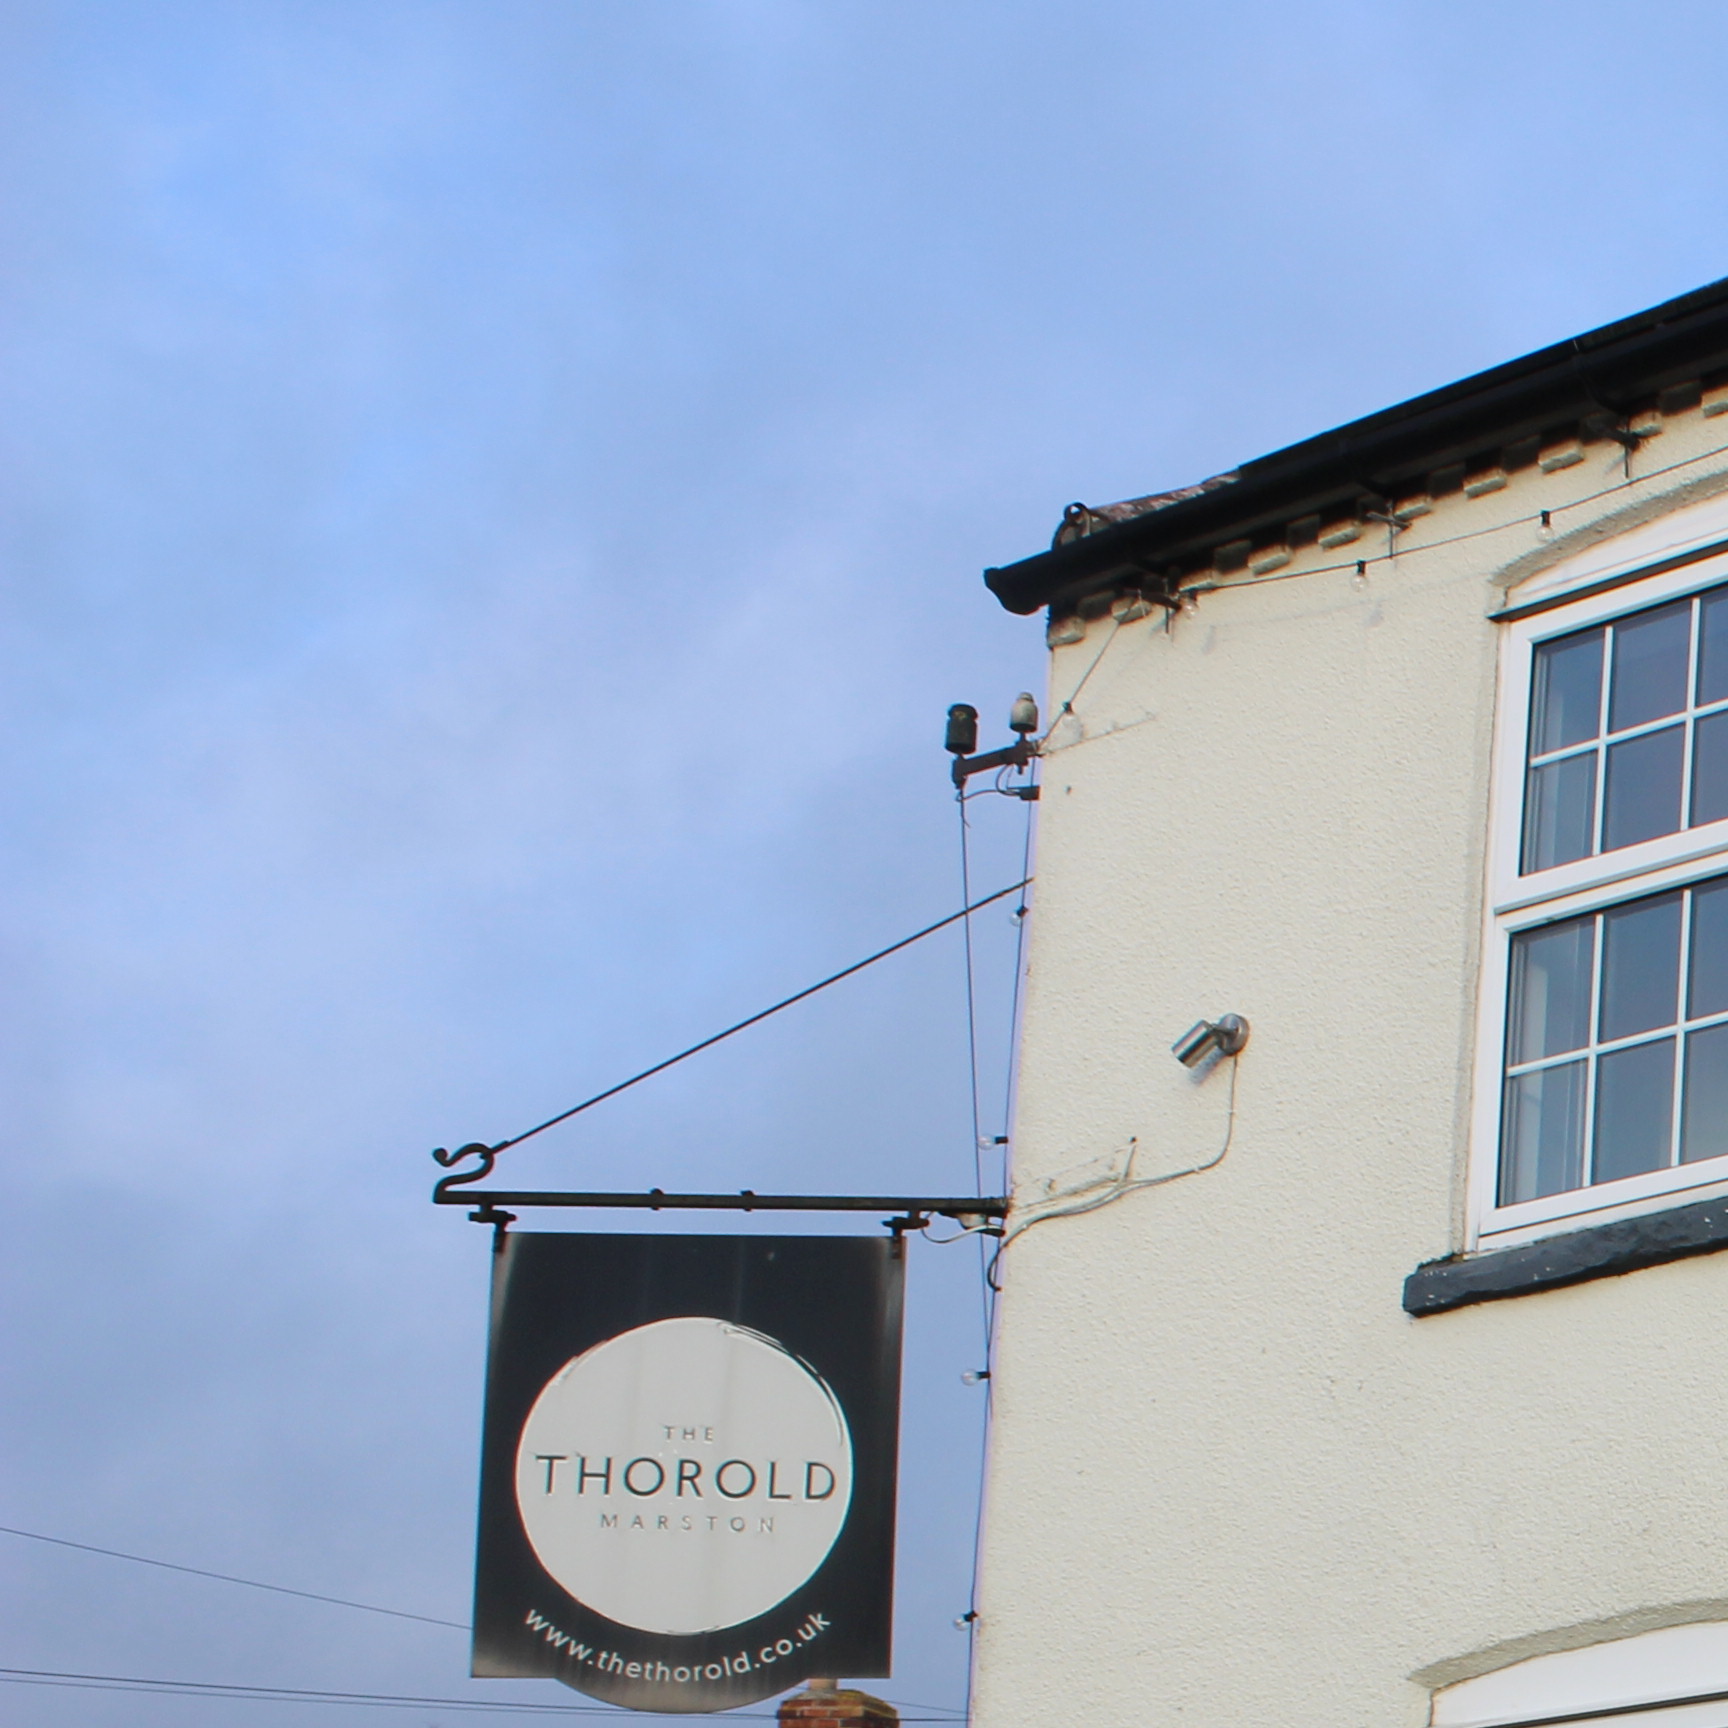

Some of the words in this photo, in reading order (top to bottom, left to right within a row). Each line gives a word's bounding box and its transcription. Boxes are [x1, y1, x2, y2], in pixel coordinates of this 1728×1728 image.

[663, 1423, 715, 1443] THE
[536, 1454, 836, 1502] THOROLD
[600, 1512, 777, 1534] MARSTON
[524, 1608, 832, 1684] www.thethorold.co.uk
